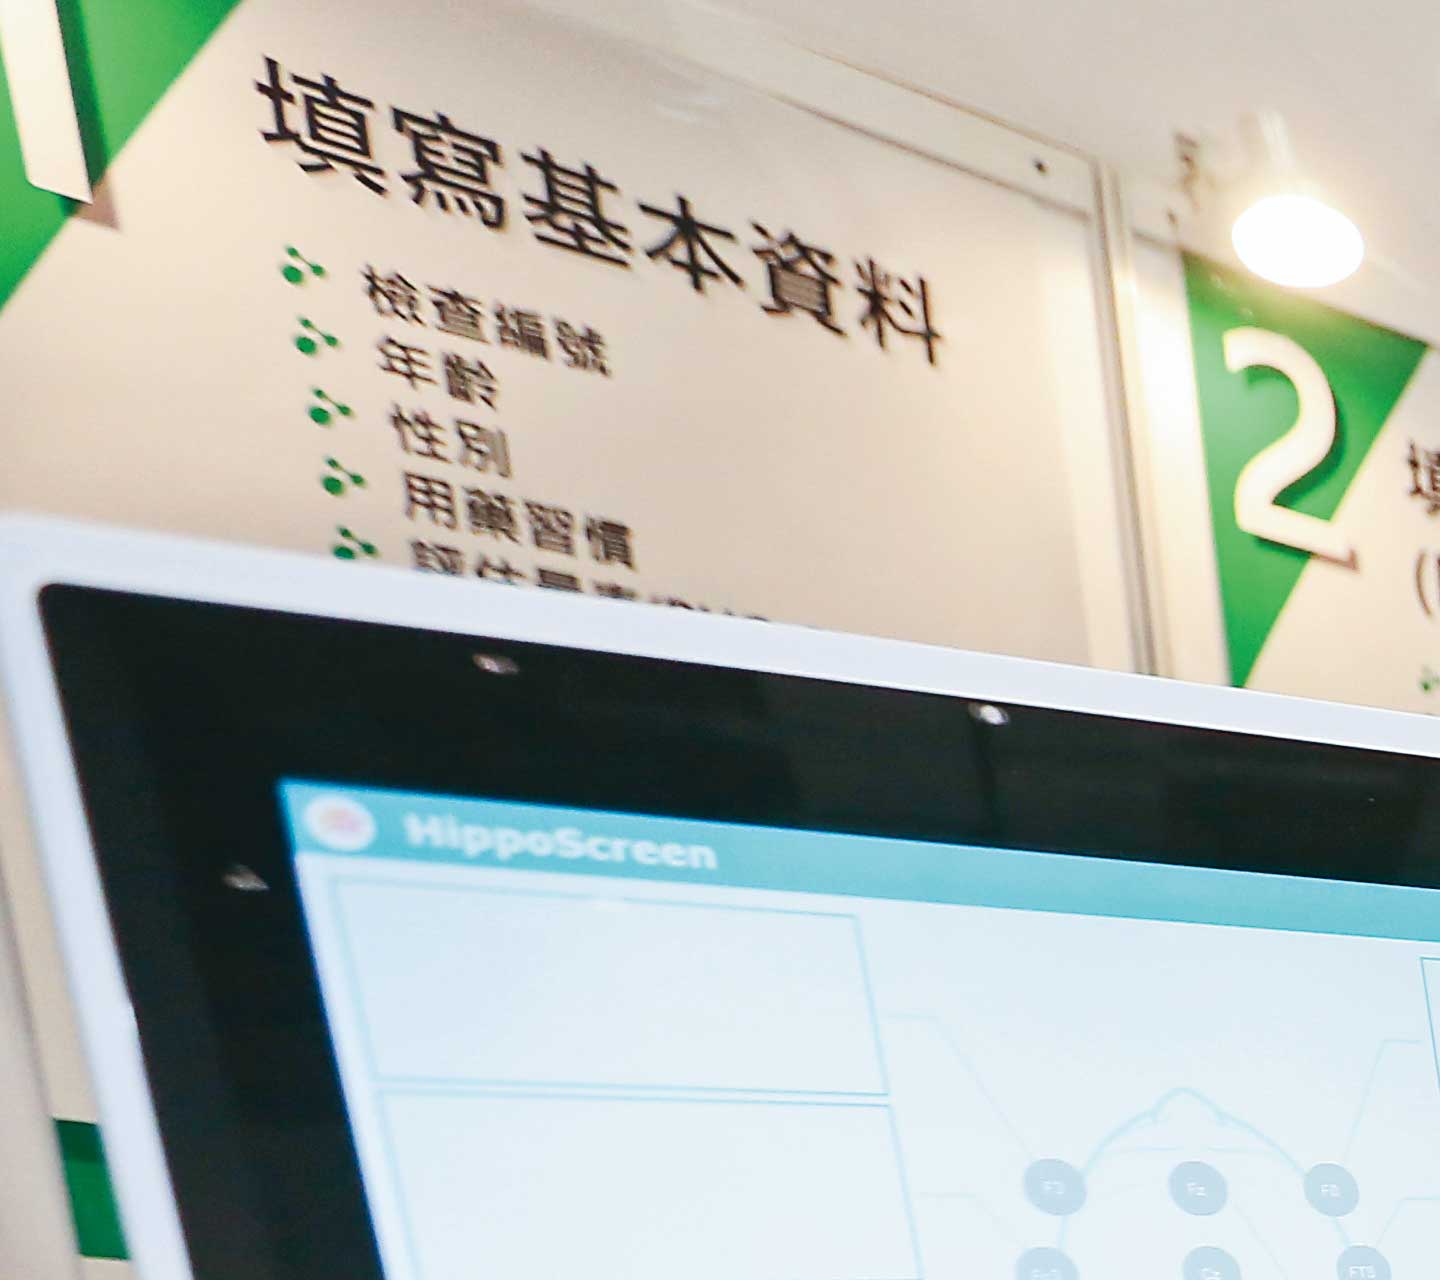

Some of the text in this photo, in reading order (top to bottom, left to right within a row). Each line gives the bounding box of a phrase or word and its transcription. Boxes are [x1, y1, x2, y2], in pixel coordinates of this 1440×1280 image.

[254, 55, 944, 366] 填寫基本資料
[361, 263, 614, 379] 檢查編號
[377, 335, 499, 411] 年齡
[390, 406, 512, 480] 性別
[1222, 327, 1356, 565] 2
[403, 471, 638, 572] 用藥習慣
[405, 811, 719, 873] HippoScreen
